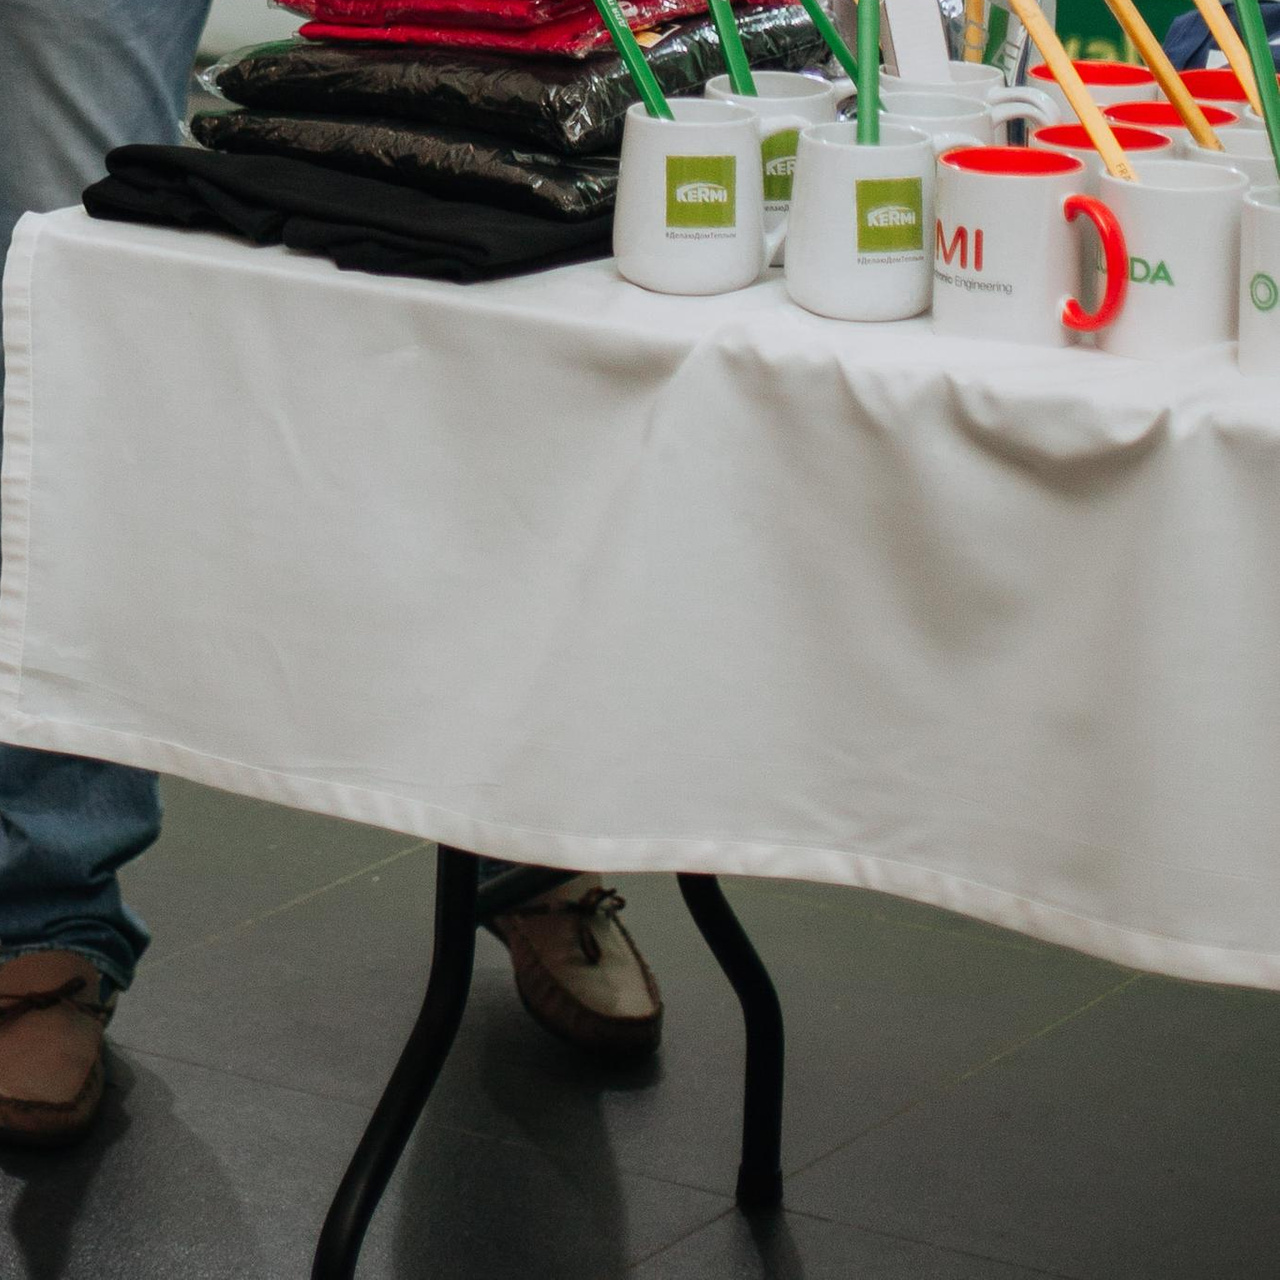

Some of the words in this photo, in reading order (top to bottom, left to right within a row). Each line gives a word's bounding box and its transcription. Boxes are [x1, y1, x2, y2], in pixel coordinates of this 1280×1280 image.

[676, 182, 728, 203] KERMI
[867, 206, 916, 228] KERMI
[954, 275, 1013, 295] Engineering
